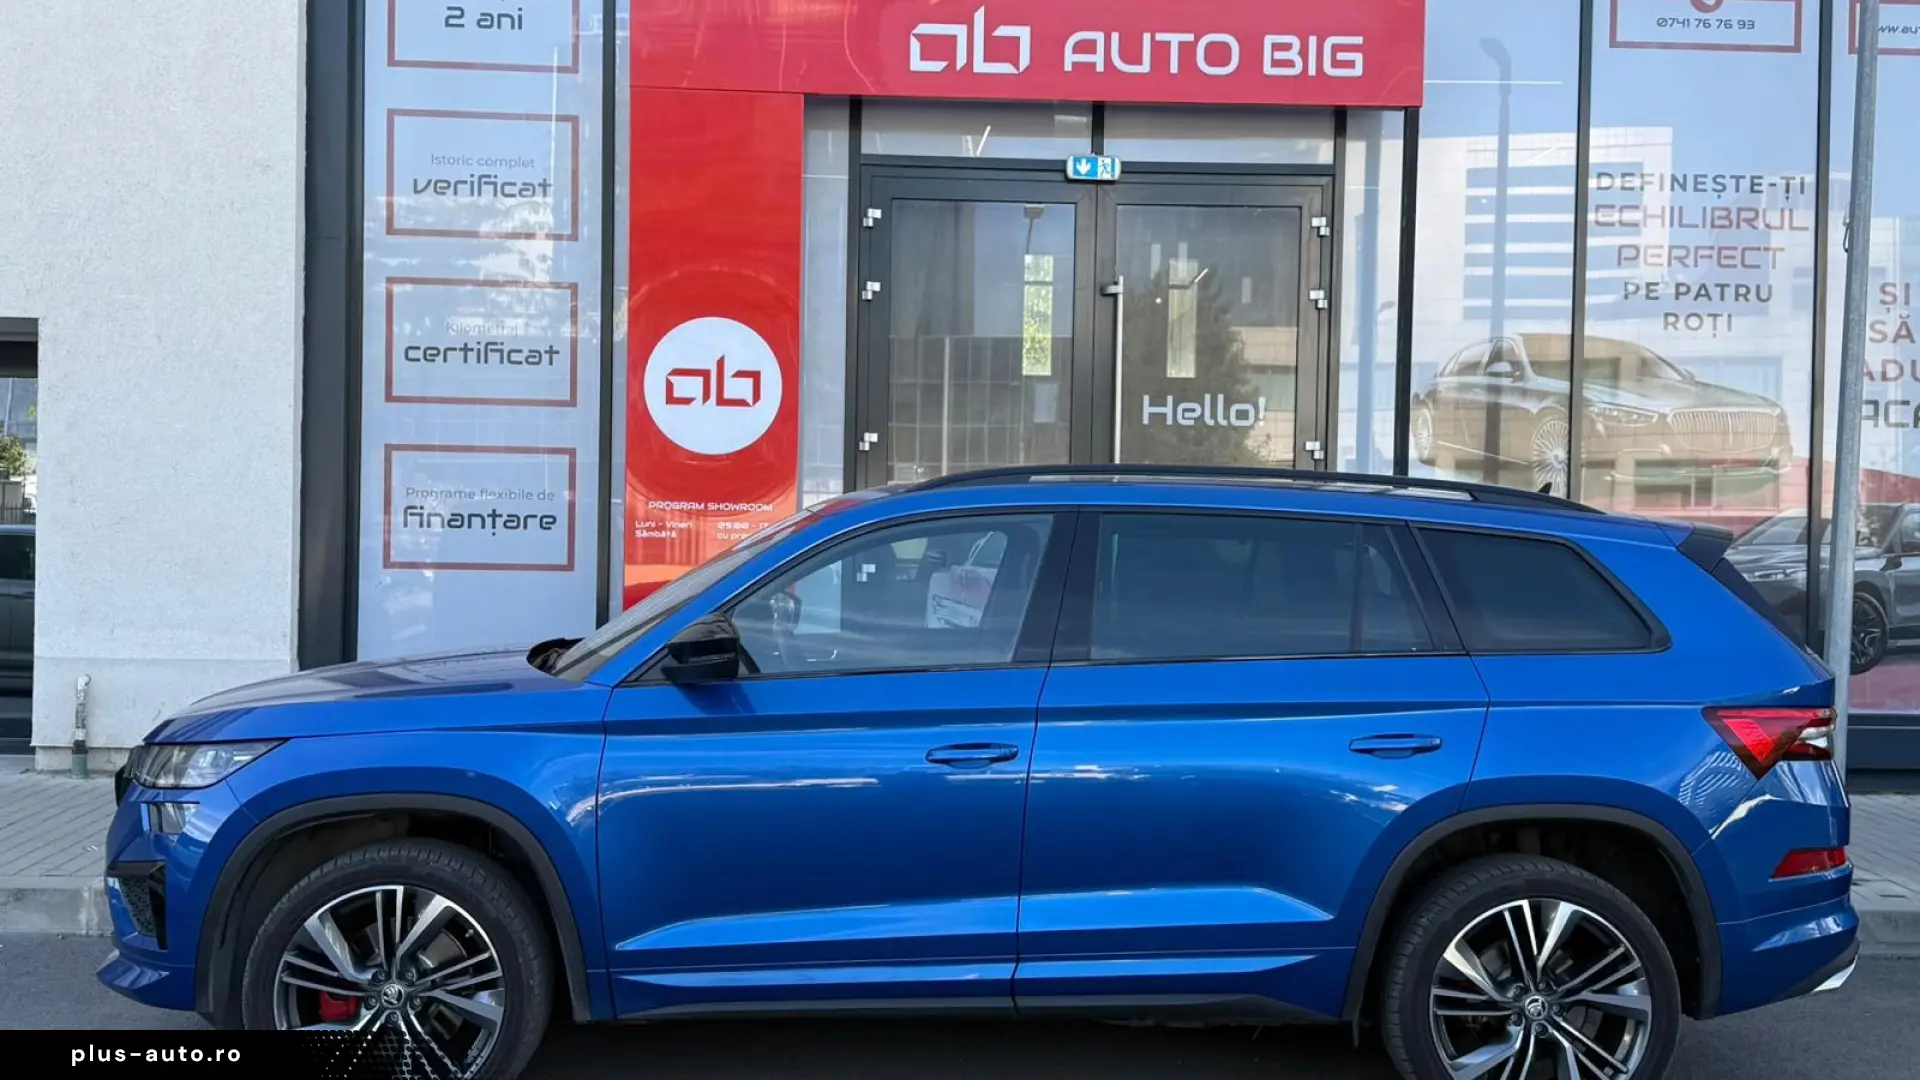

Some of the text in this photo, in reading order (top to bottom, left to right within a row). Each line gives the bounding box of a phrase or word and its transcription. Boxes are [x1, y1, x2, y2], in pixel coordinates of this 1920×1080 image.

[445, 6, 523, 30] 2 ani
[1656, 17, 1755, 30] 0741 76 76 93
[1064, 31, 1240, 76] AUTO
[1263, 35, 1363, 77] BIG
[430, 153, 535, 170] Istoric complet
[413, 173, 552, 199] verificat
[1595, 172, 1805, 200] DEFINEȘTE-ȚI
[1594, 204, 1809, 231] ECHILIBRUL
[1617, 244, 1785, 269] PERFECT
[1623, 281, 1772, 303] PE PATRU
[1879, 282, 1911, 313] ȘI
[1663, 312, 1733, 338] ROȚI
[1868, 313, 1916, 343] SĂ
[404, 341, 560, 366] certificat
[1142, 393, 1267, 427] Hello!
[406, 487, 555, 501] Programe flexibile de
[648, 501, 773, 512] PROGRAM SHOWROOM
[403, 505, 557, 536] finanțare
[635, 520, 656, 528] Luni
